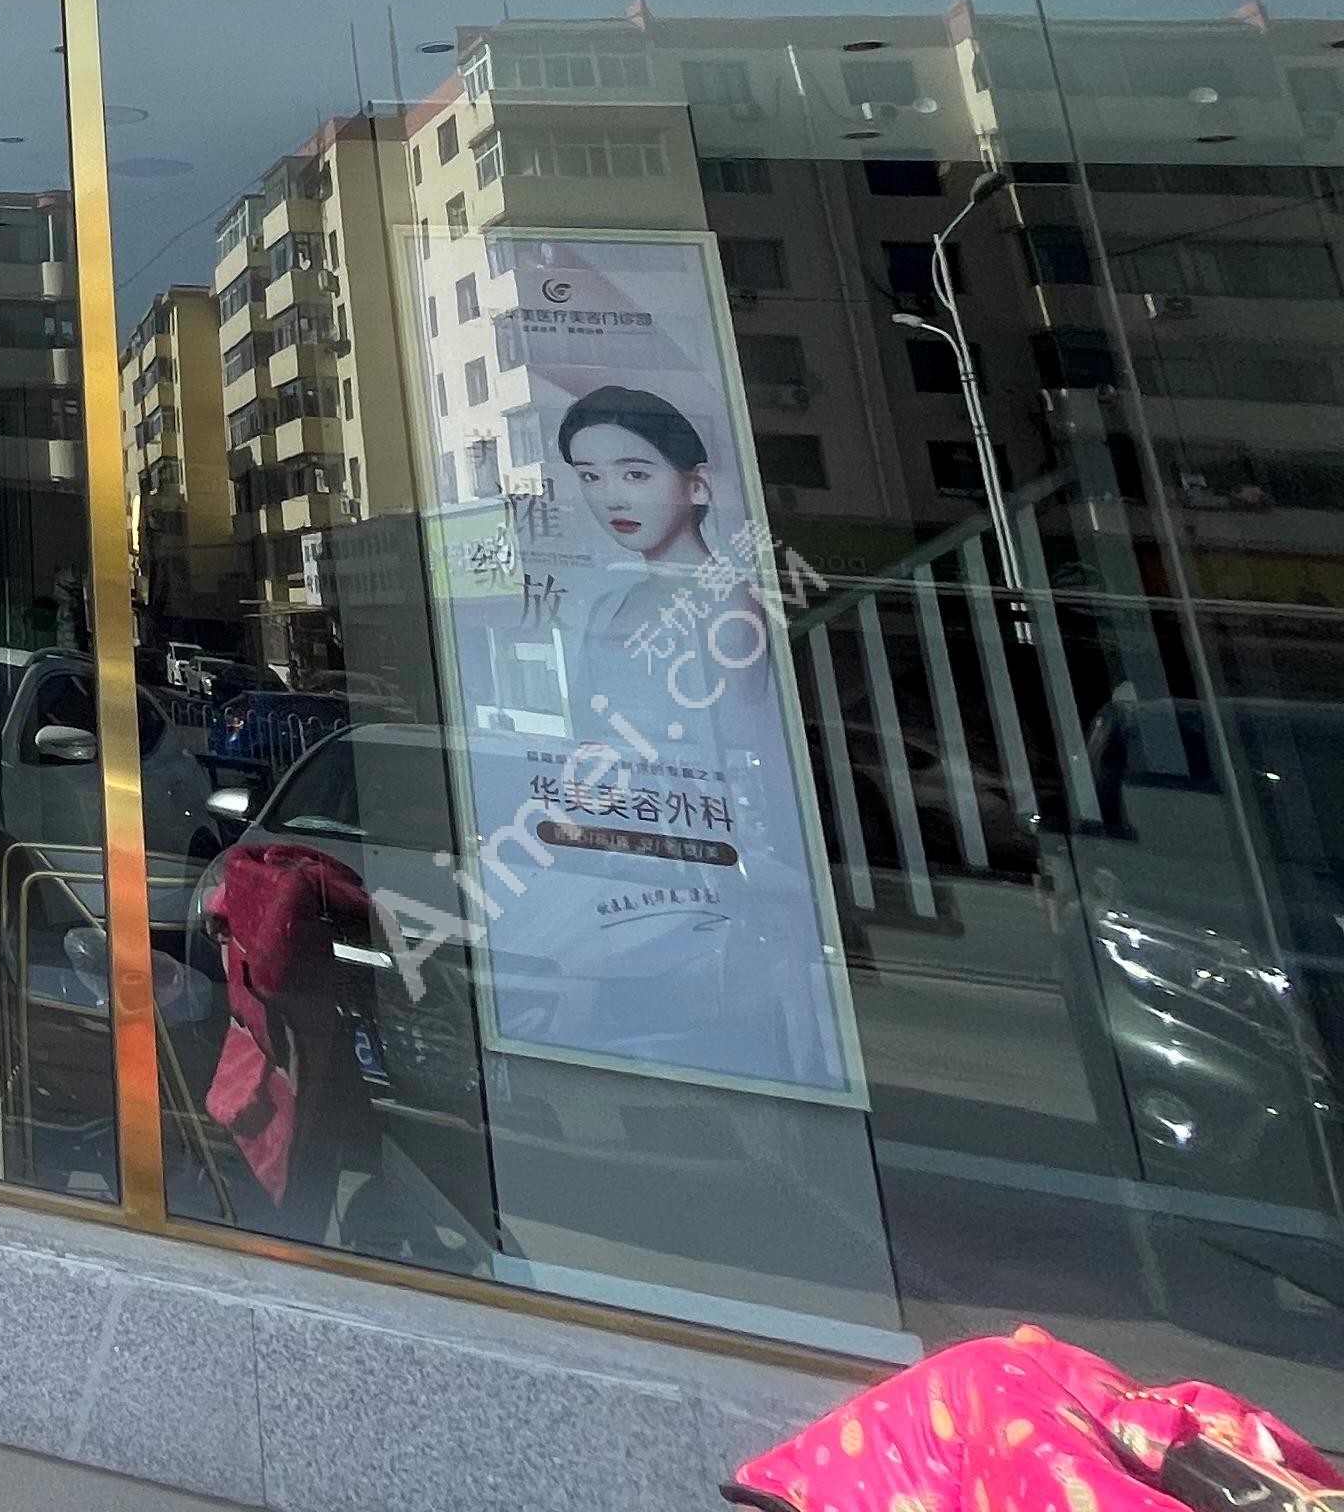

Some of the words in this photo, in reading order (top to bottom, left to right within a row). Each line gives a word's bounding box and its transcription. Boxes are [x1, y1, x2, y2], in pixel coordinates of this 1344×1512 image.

[530, 774, 734, 831] 华美美容外科
